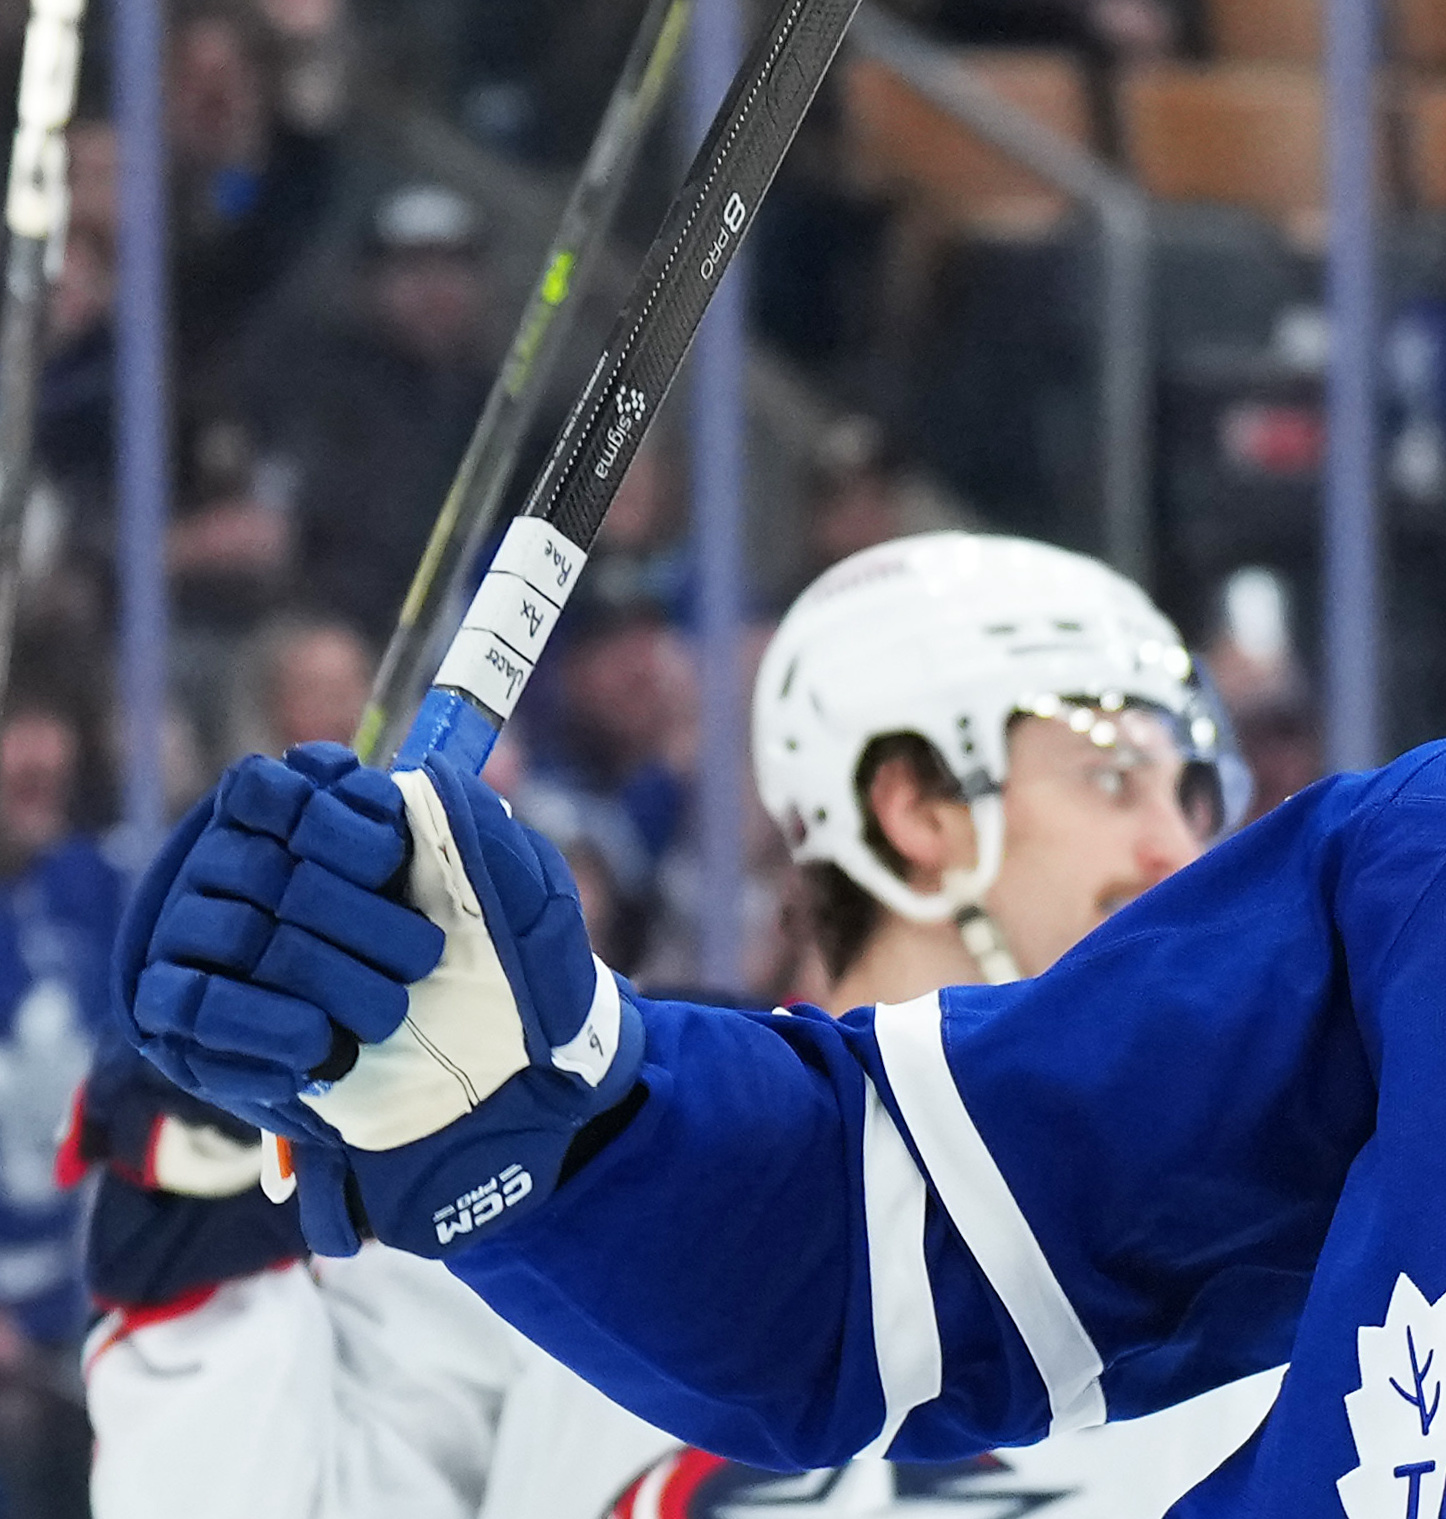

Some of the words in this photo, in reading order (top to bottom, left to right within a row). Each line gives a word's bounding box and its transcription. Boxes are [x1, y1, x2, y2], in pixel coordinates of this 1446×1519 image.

[699, 232, 731, 281] PRO
[594, 415, 634, 482] sigma
[543, 539, 573, 588] Rae
[520, 599, 544, 638] Ax
[436, 1170, 533, 1244] CCM
